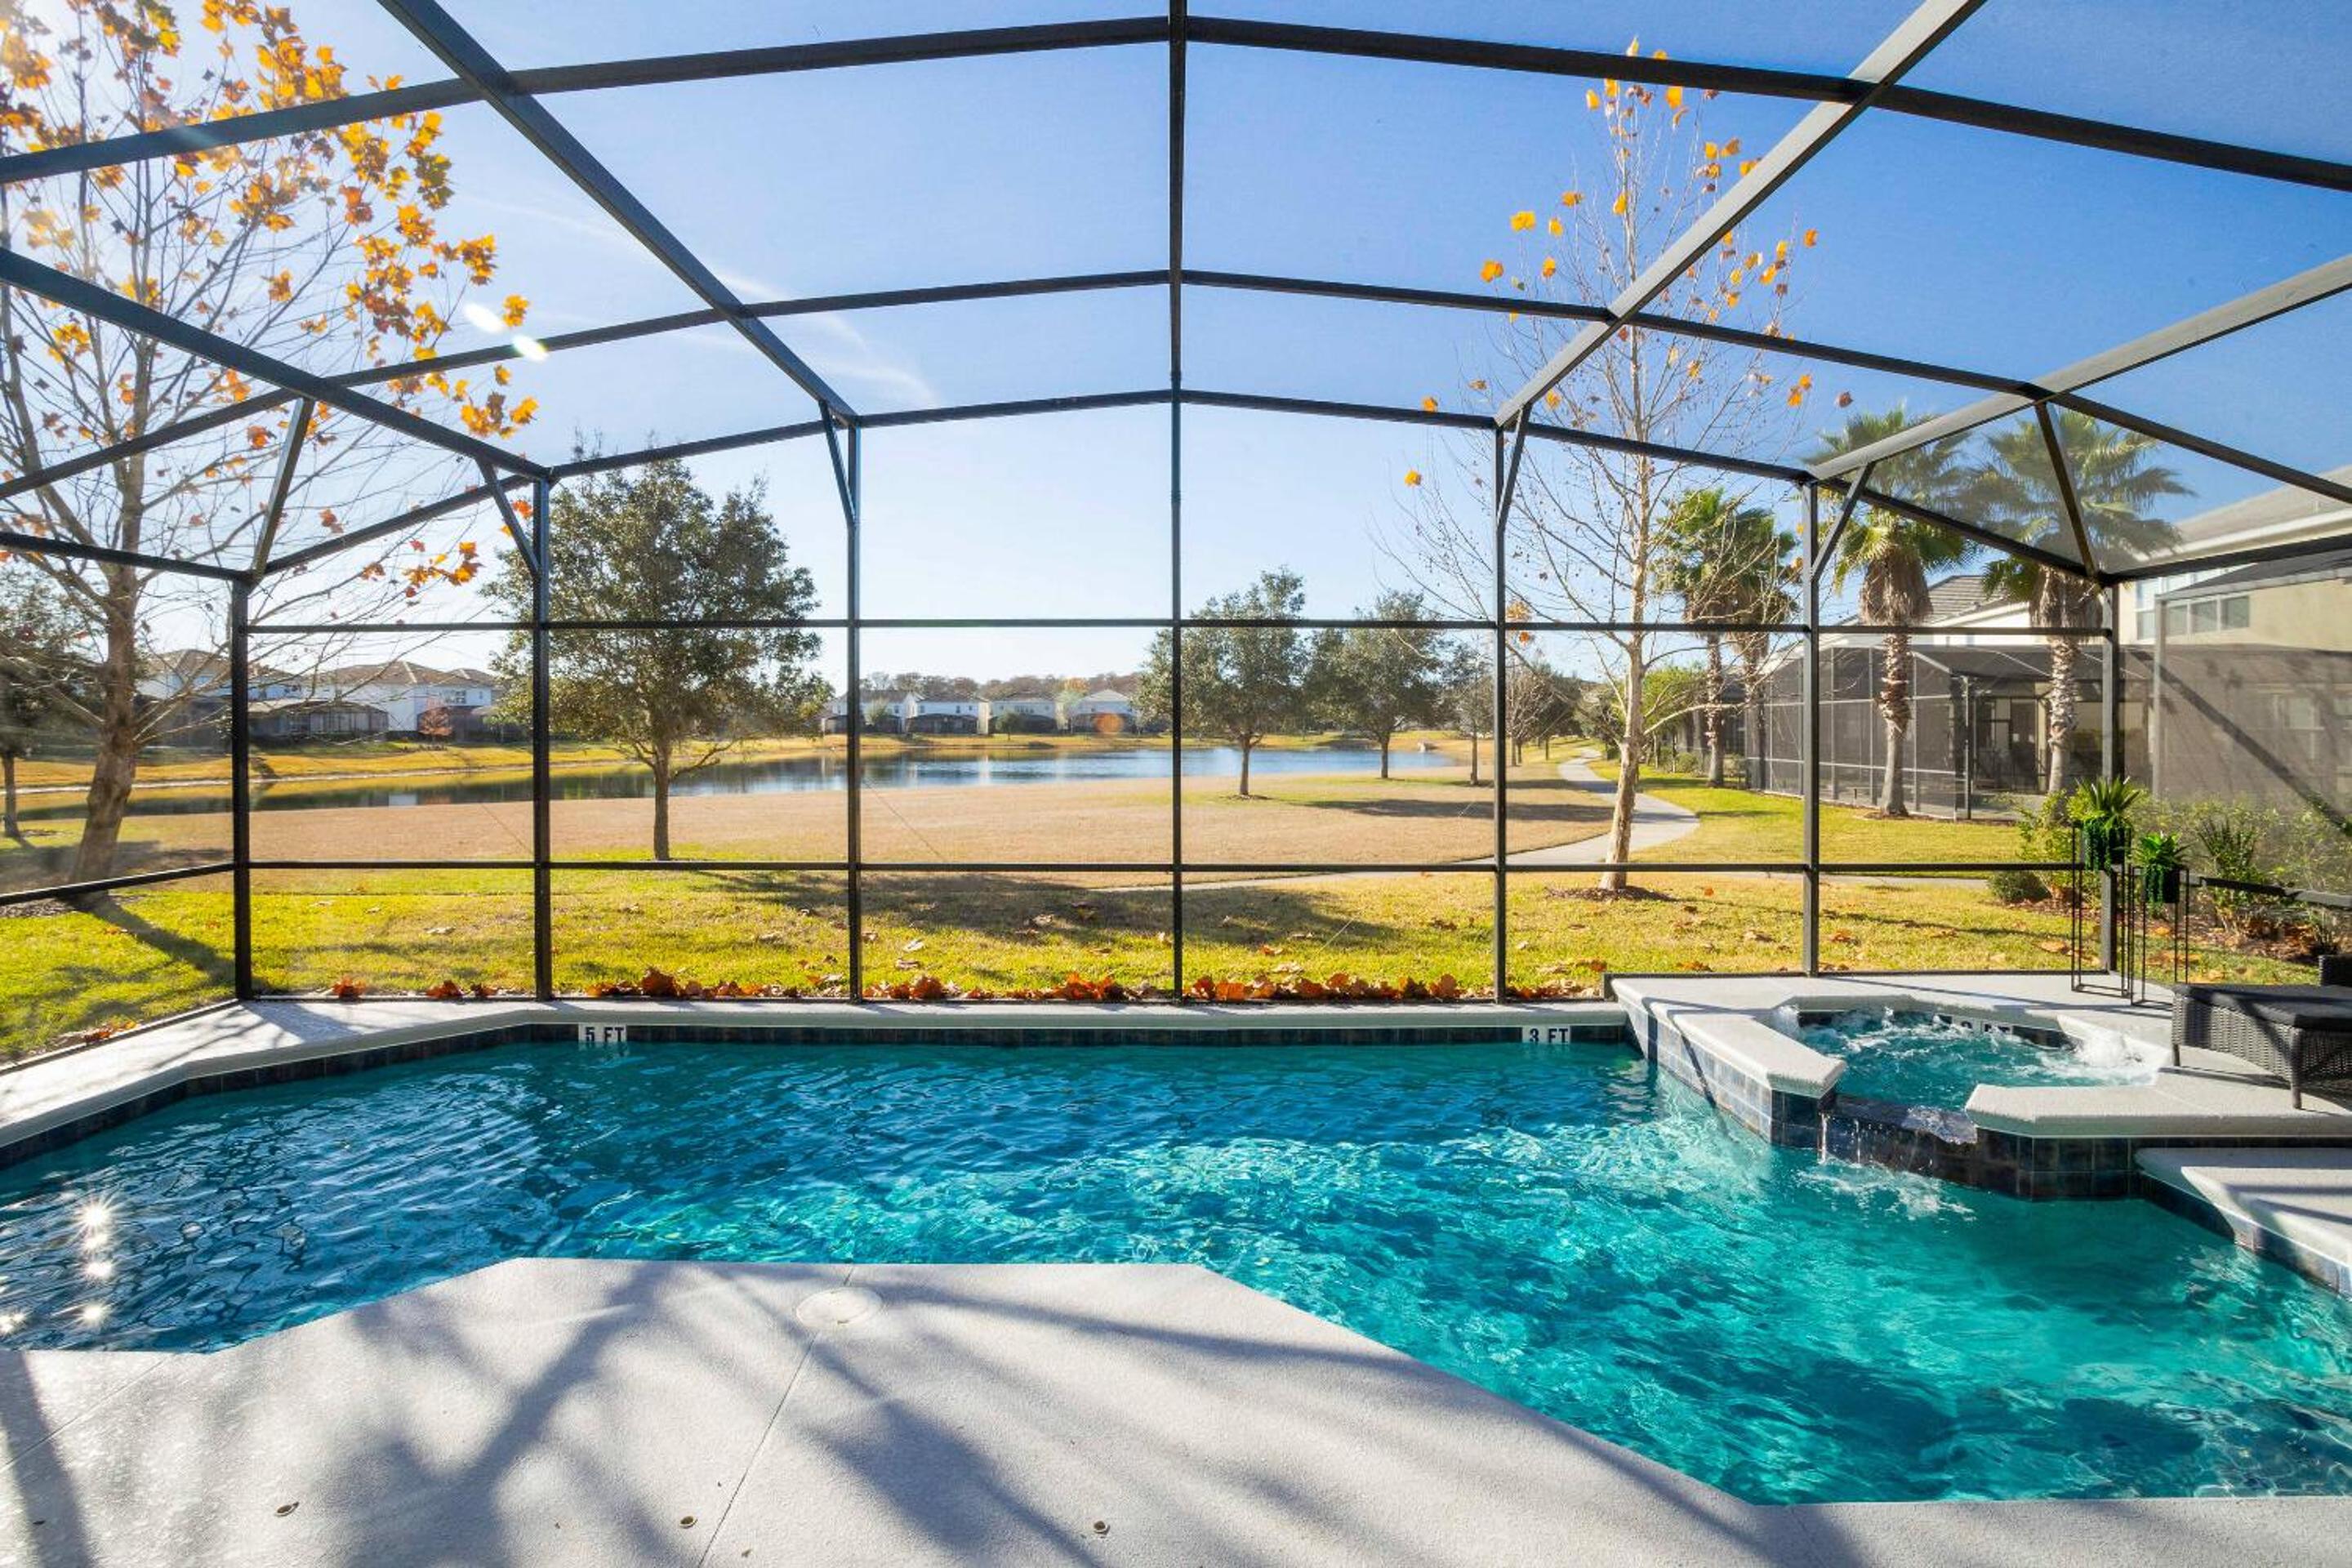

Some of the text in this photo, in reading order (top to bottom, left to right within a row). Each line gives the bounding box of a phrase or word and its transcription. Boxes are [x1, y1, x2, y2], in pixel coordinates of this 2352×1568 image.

[586, 1027, 625, 1042] 5 FT
[1548, 1028, 1568, 1043] FT
